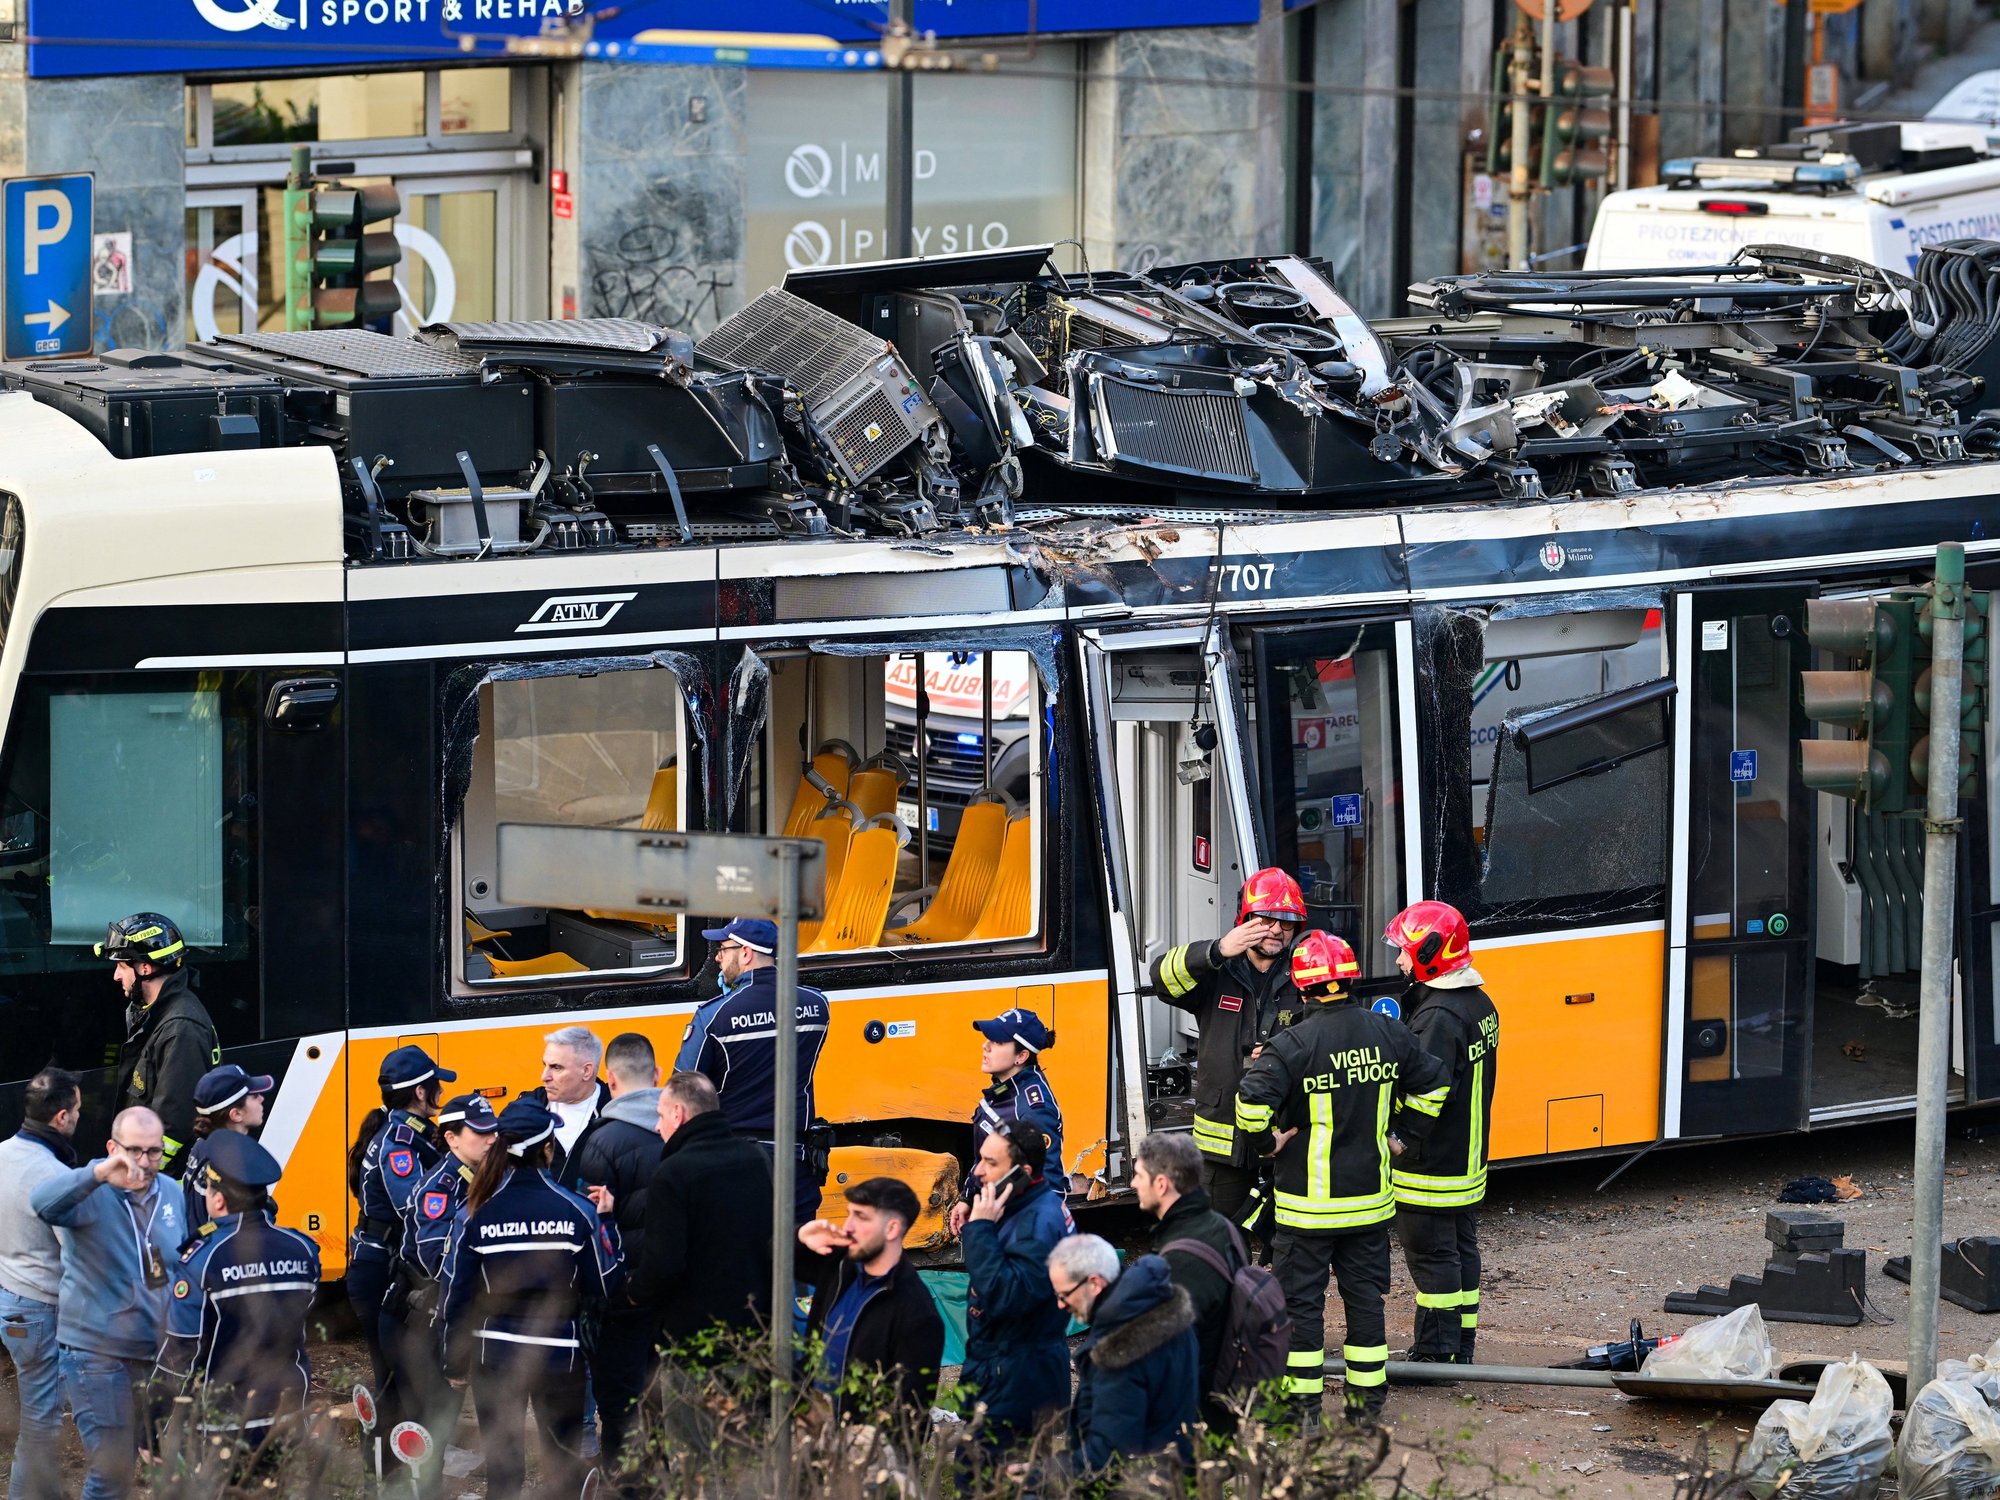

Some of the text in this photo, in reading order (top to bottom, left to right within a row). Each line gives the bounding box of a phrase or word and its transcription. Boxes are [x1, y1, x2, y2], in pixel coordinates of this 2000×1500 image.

[321, 0, 426, 26] SPORT
[476, 0, 584, 19] REHAB
[855, 150, 937, 182] MD
[24, 189, 72, 275] P
[855, 222, 1009, 259] PYSIO
[1638, 223, 1825, 246] PROTEZIONE CIVILE
[1909, 222, 1955, 252] POSTO
[1568, 553, 1593, 561] Milano
[1209, 563, 1275, 592] 7707
[551, 603, 599, 622] ATM
[731, 1011, 776, 1029] POLIZIA
[1329, 1046, 1381, 1070] VIGILI
[1468, 1039, 1486, 1061] DEL
[1303, 1072, 1341, 1094] DEL
[309, 1214, 320, 1231] B
[480, 1222, 529, 1239] POLIZIA
[222, 1260, 309, 1282] POLIZIA LOCALE
